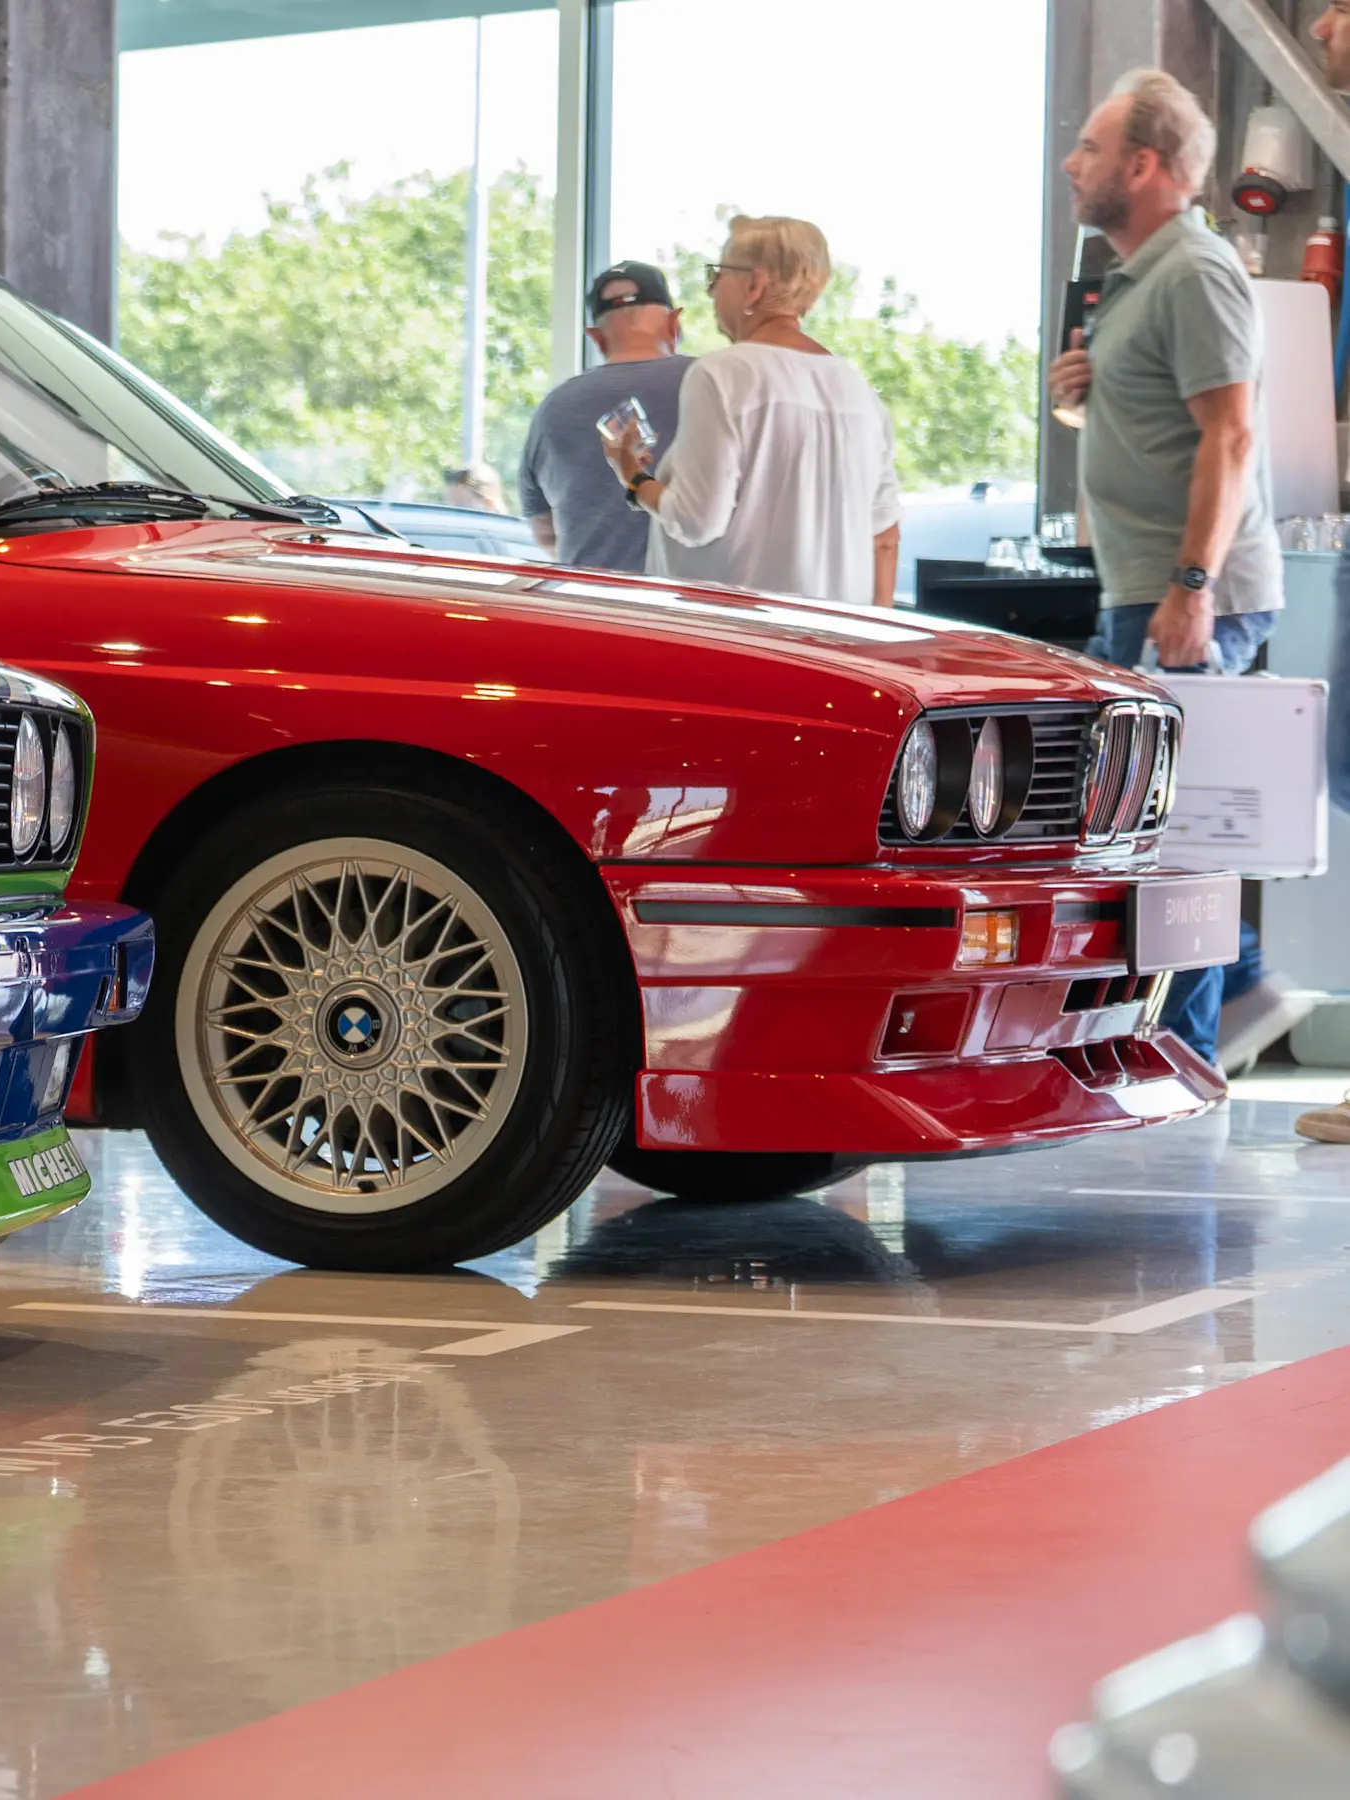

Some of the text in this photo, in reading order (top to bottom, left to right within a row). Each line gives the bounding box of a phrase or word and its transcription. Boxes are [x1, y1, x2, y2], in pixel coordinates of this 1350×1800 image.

[347, 1020, 381, 1053] BMW
[15, 1432, 153, 1457] M3
[100, 1403, 274, 1430] E30
